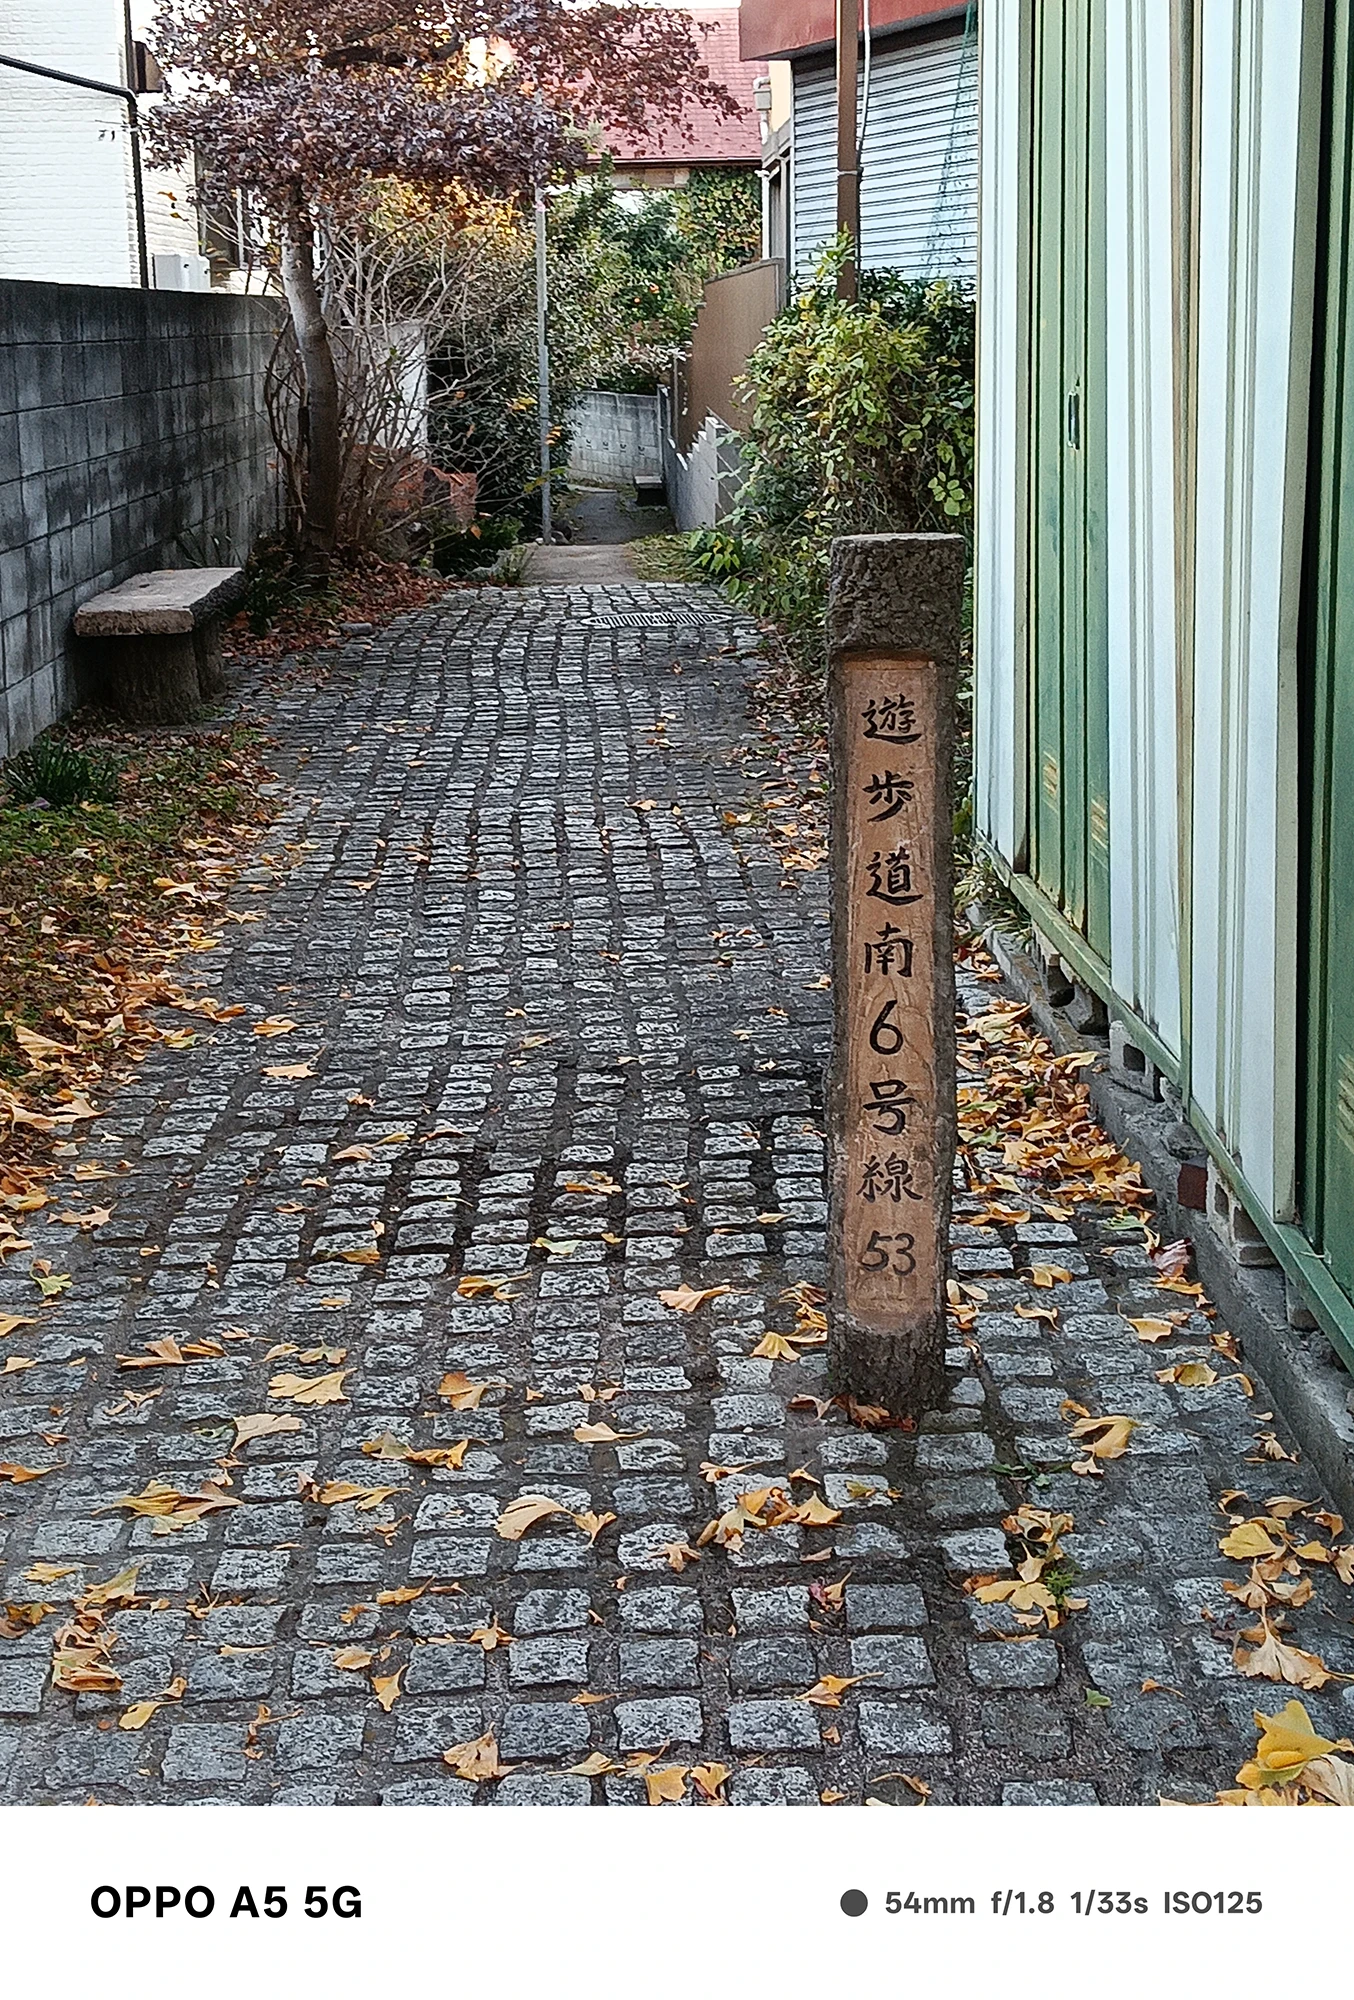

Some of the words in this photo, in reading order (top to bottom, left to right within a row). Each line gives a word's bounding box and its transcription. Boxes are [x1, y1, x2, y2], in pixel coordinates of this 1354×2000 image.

[856, 693, 924, 1276] 遊歩道南6号線53
